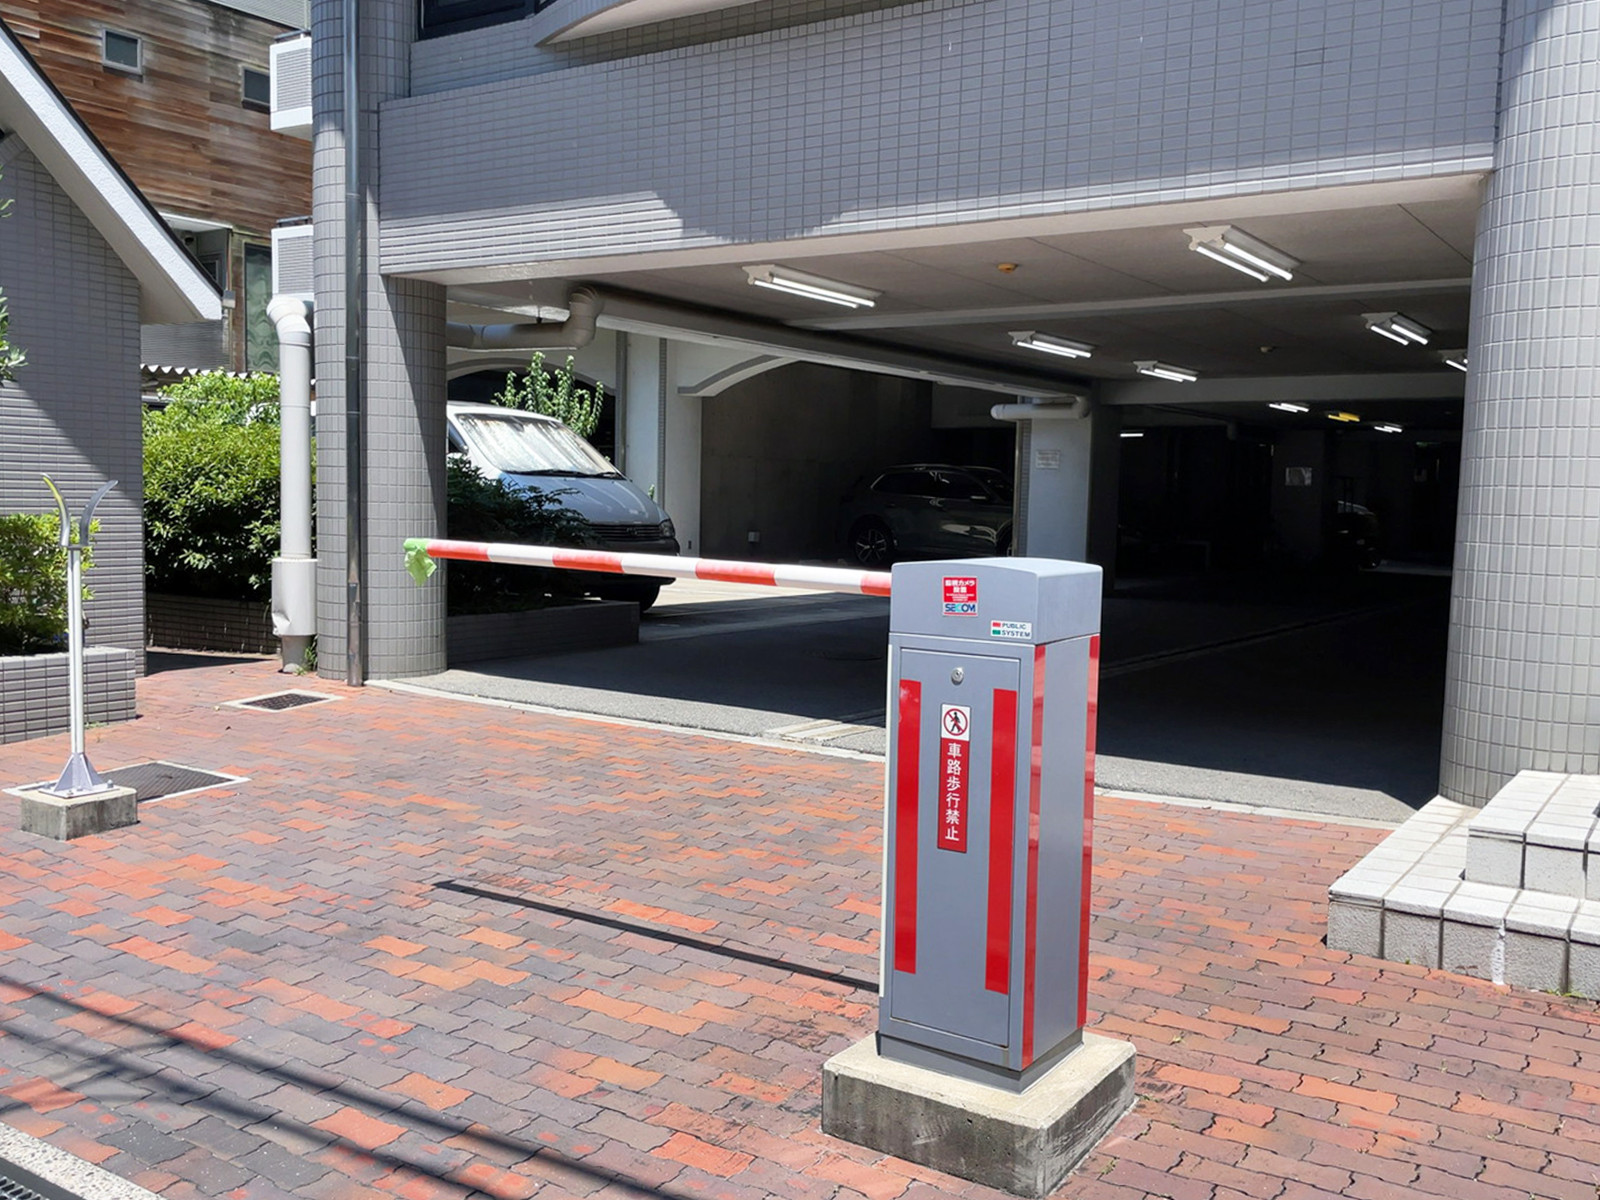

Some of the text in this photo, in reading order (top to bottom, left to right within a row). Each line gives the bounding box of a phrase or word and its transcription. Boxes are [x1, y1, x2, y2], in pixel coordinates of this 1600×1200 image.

[944, 603, 976, 612] SECOM
[1002, 622, 1027, 630] PUBLIC
[1001, 629, 1031, 637] SYSTEM
[944, 742, 962, 842] 車路歩行禁止
